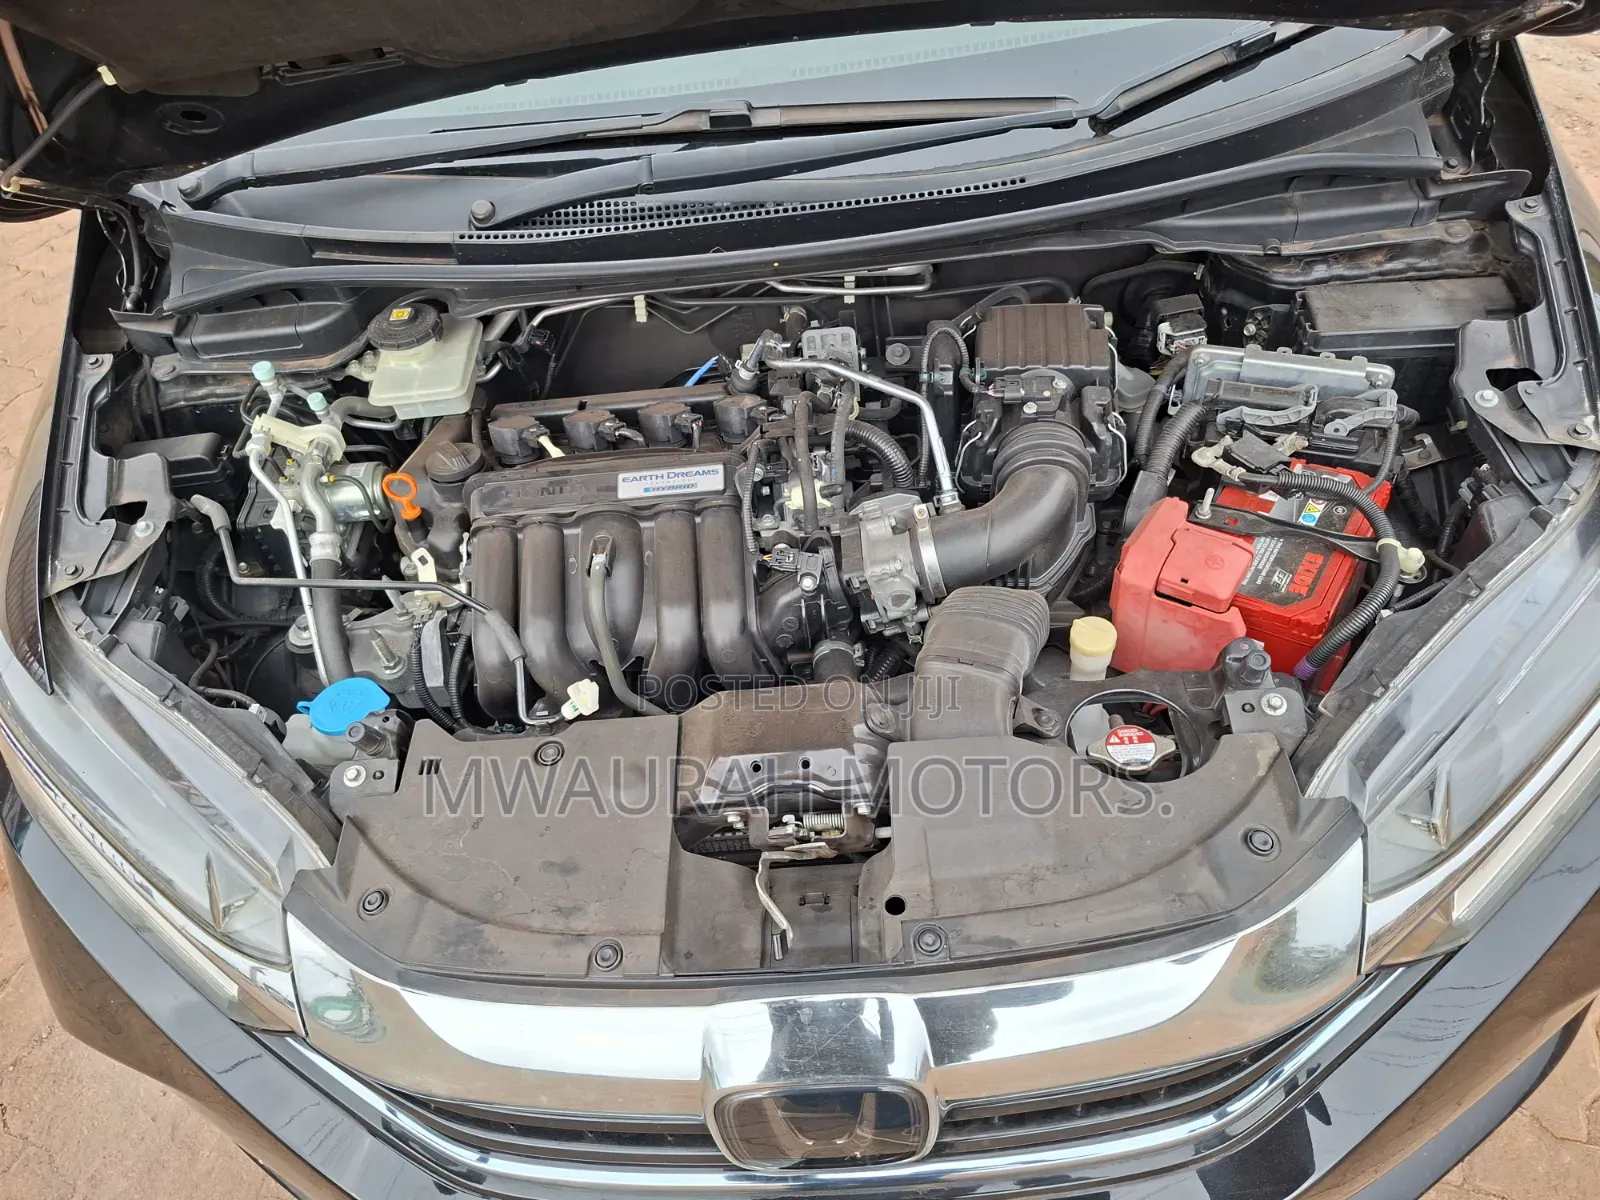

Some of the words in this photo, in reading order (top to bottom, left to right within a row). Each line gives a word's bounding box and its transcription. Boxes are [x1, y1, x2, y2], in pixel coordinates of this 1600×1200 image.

[622, 474, 664, 483] EARTH
[667, 469, 719, 479] DREAMS
[652, 483, 695, 492] HYBRID
[1288, 552, 1324, 596] EXIDE
